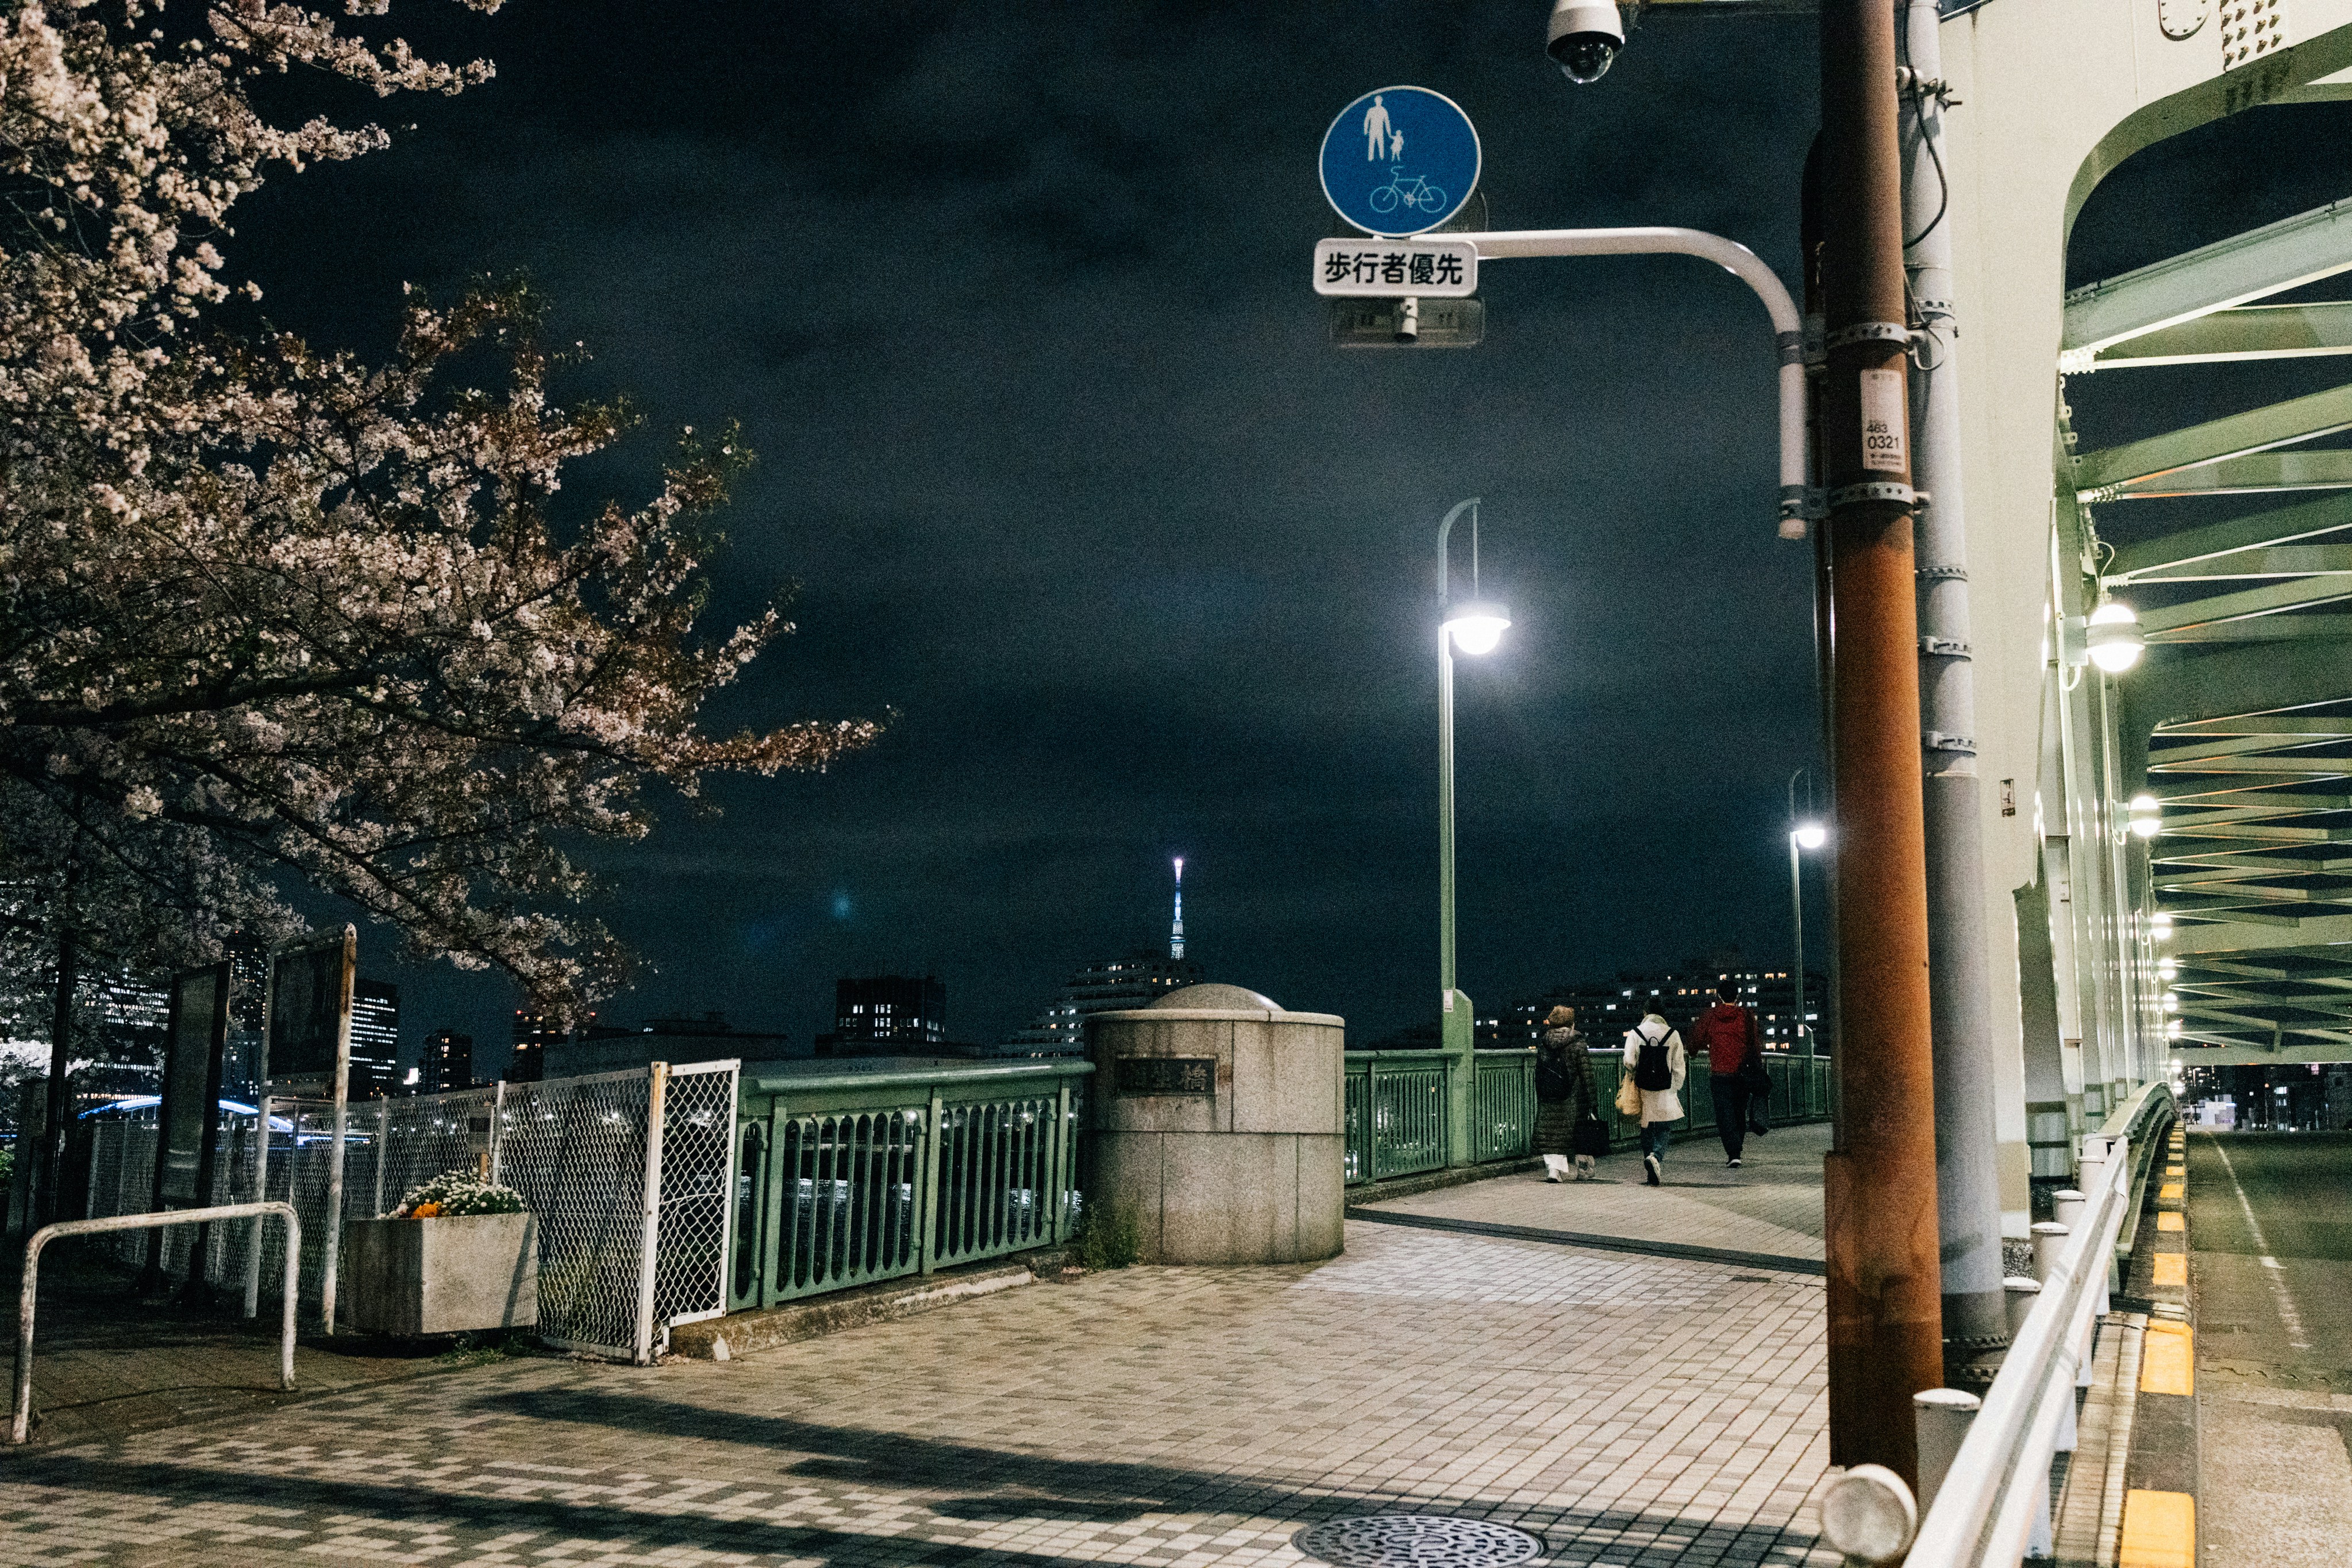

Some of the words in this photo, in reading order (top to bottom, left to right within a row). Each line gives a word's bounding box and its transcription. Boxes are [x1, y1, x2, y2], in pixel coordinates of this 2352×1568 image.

[1325, 252, 1463, 285] 歩行者優先
[1867, 435, 1899, 450] 0321
